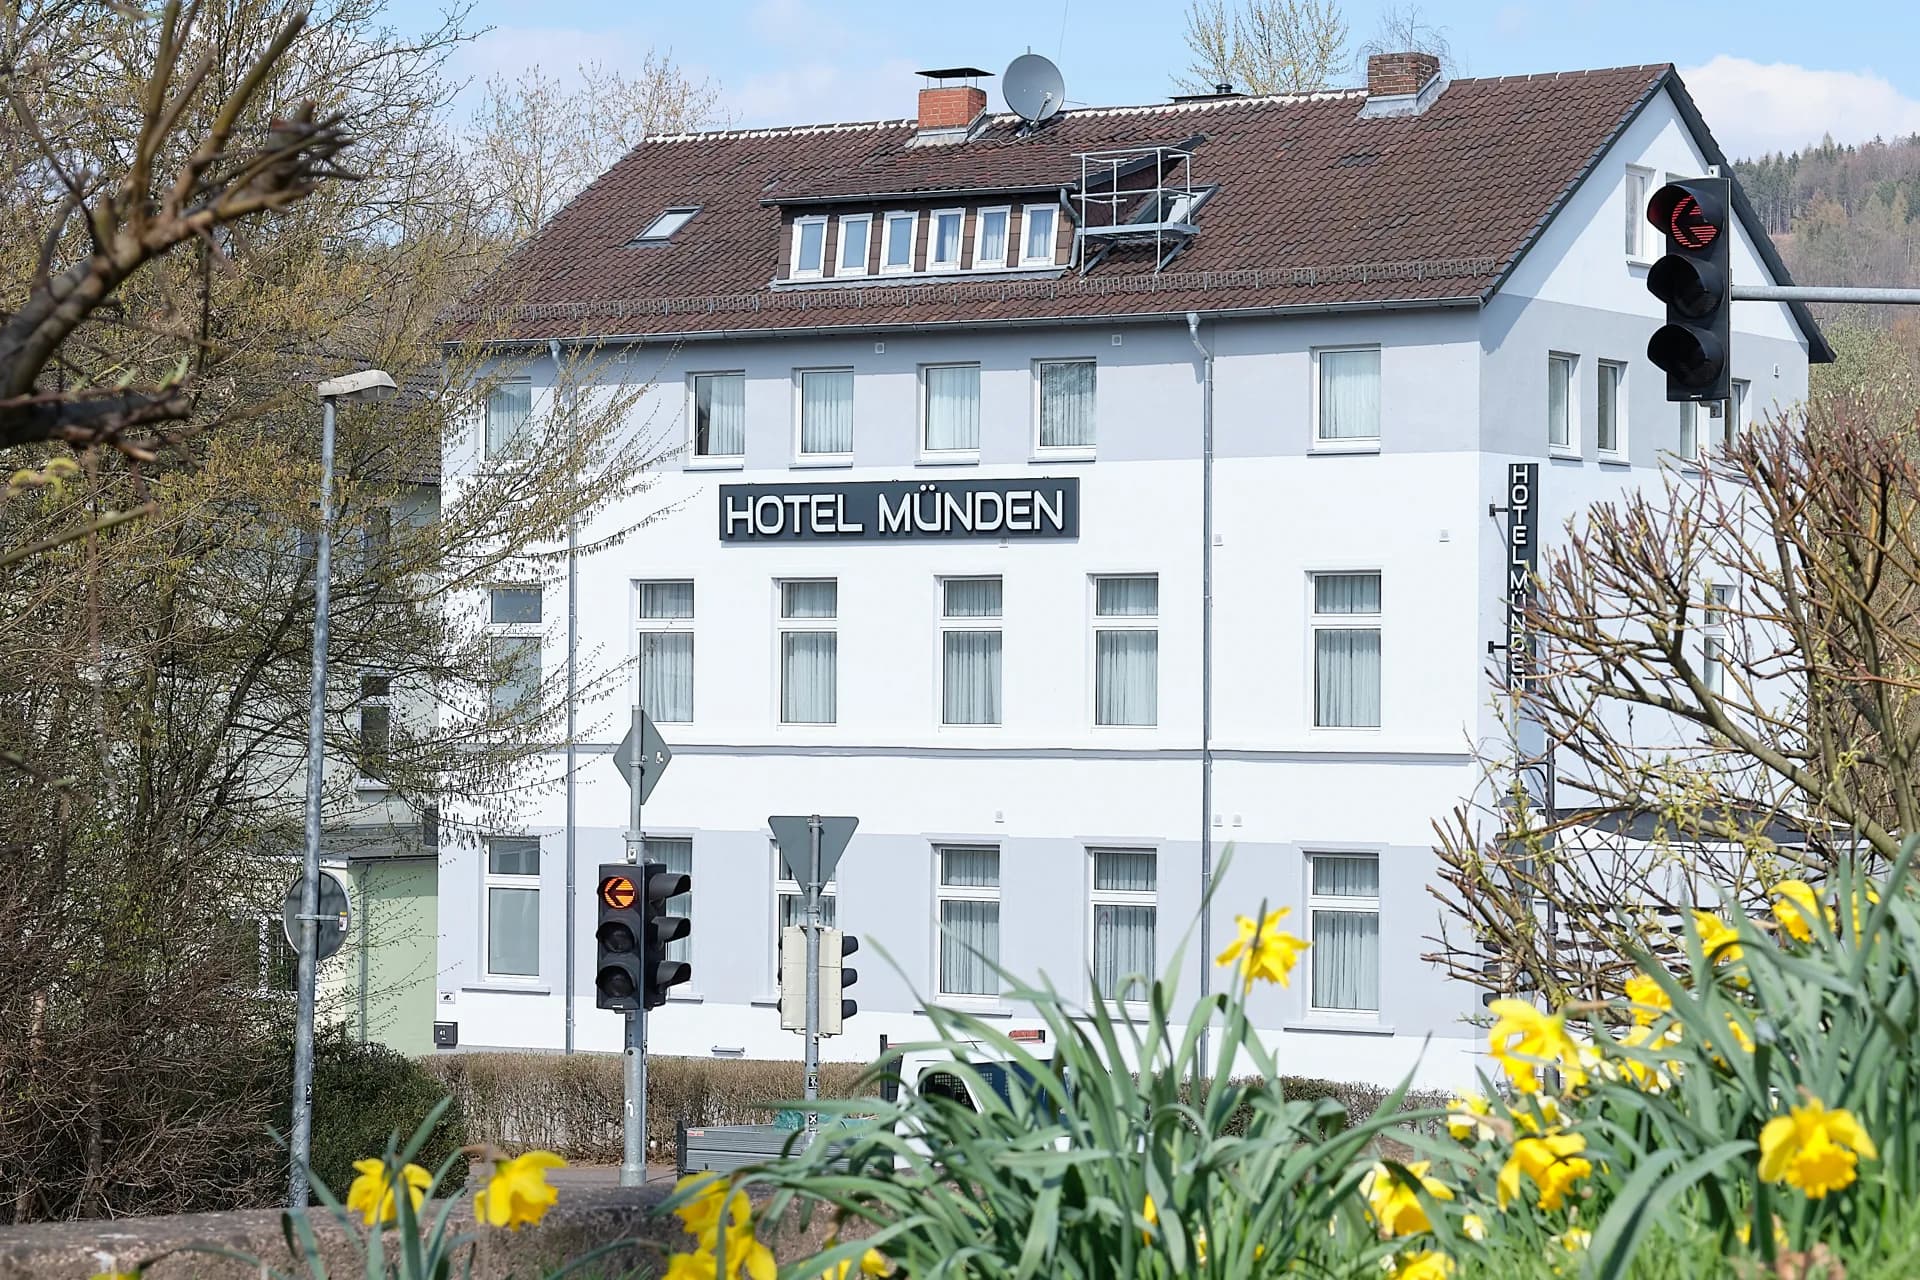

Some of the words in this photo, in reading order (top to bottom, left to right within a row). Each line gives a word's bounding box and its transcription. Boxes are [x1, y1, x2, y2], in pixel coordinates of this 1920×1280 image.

[726, 494, 863, 535] HOTEL
[878, 484, 1064, 533] MÜNDEN
[1511, 464, 1529, 565] HOTEL
